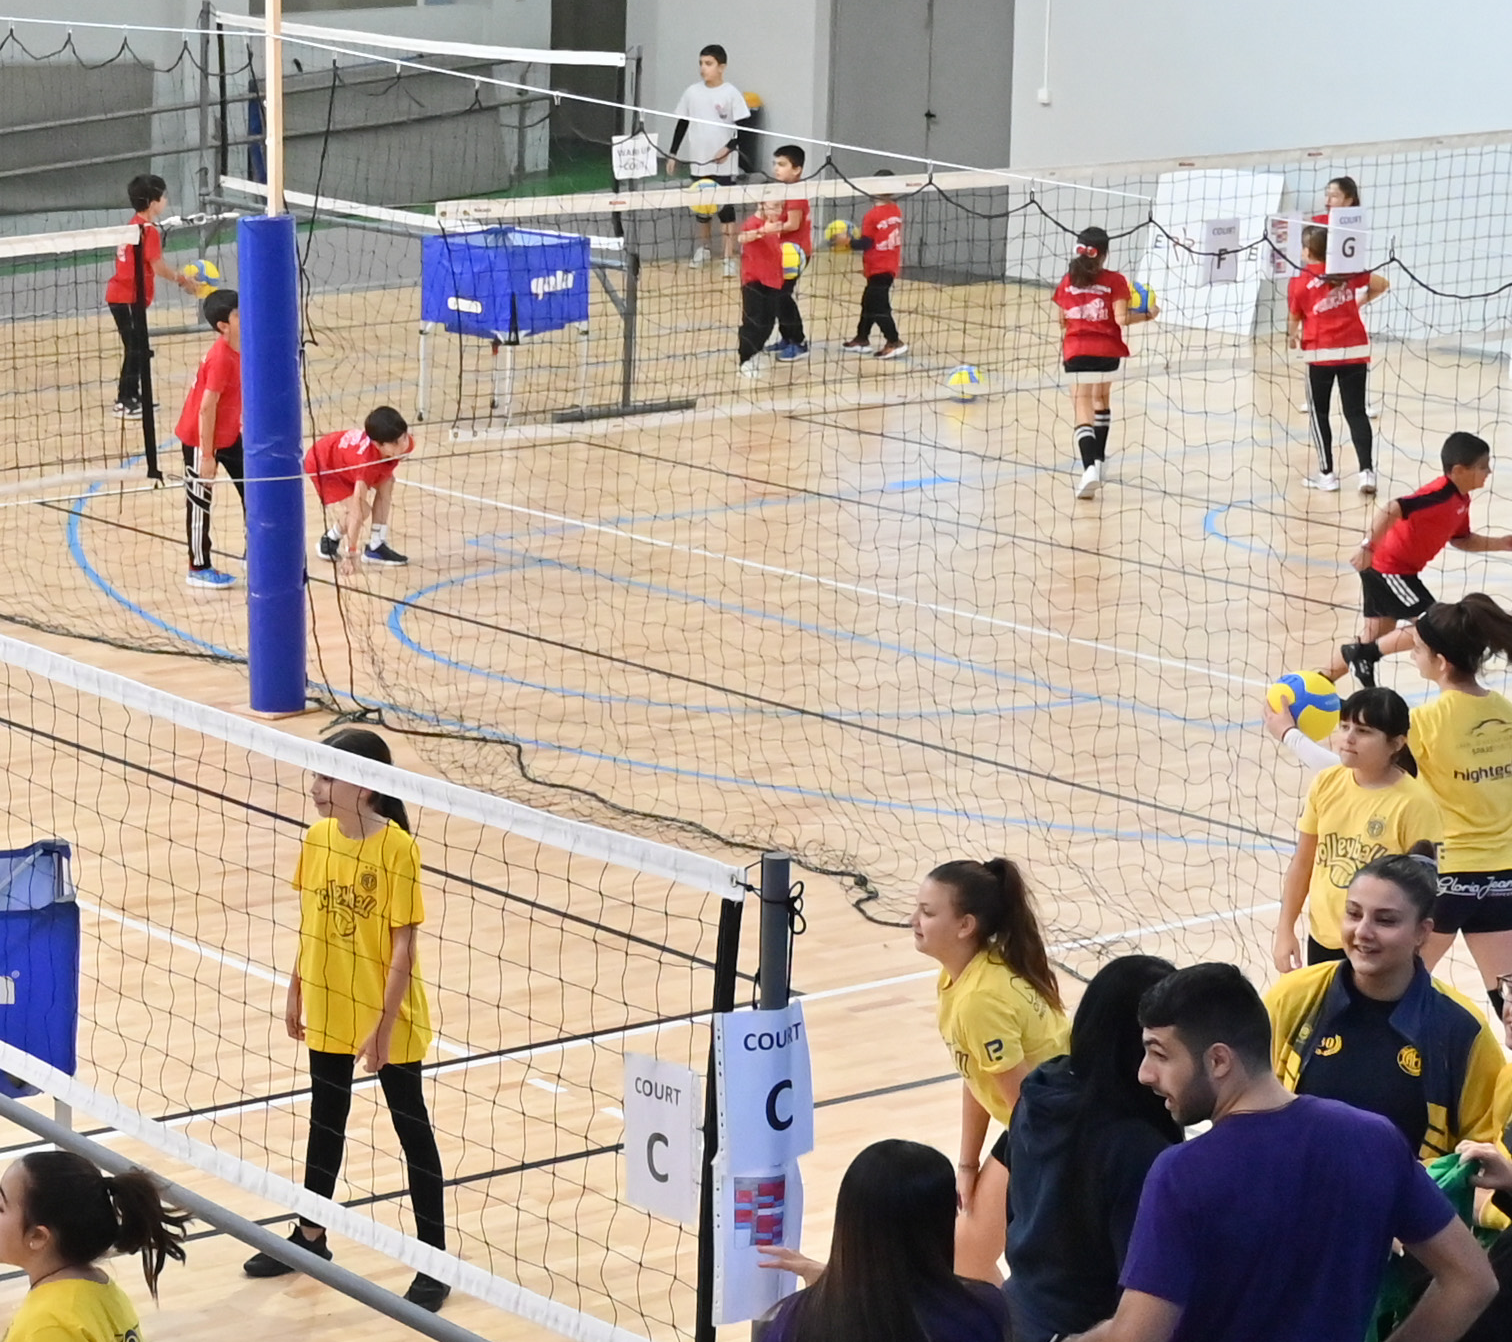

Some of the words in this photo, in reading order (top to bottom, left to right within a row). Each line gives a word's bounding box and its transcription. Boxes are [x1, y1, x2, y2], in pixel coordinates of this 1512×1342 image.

[1341, 236, 1356, 259] G
[743, 1022, 801, 1051] COURT
[635, 1077, 682, 1106] COURT
[765, 1079, 793, 1131] C
[646, 1132, 669, 1183] C
